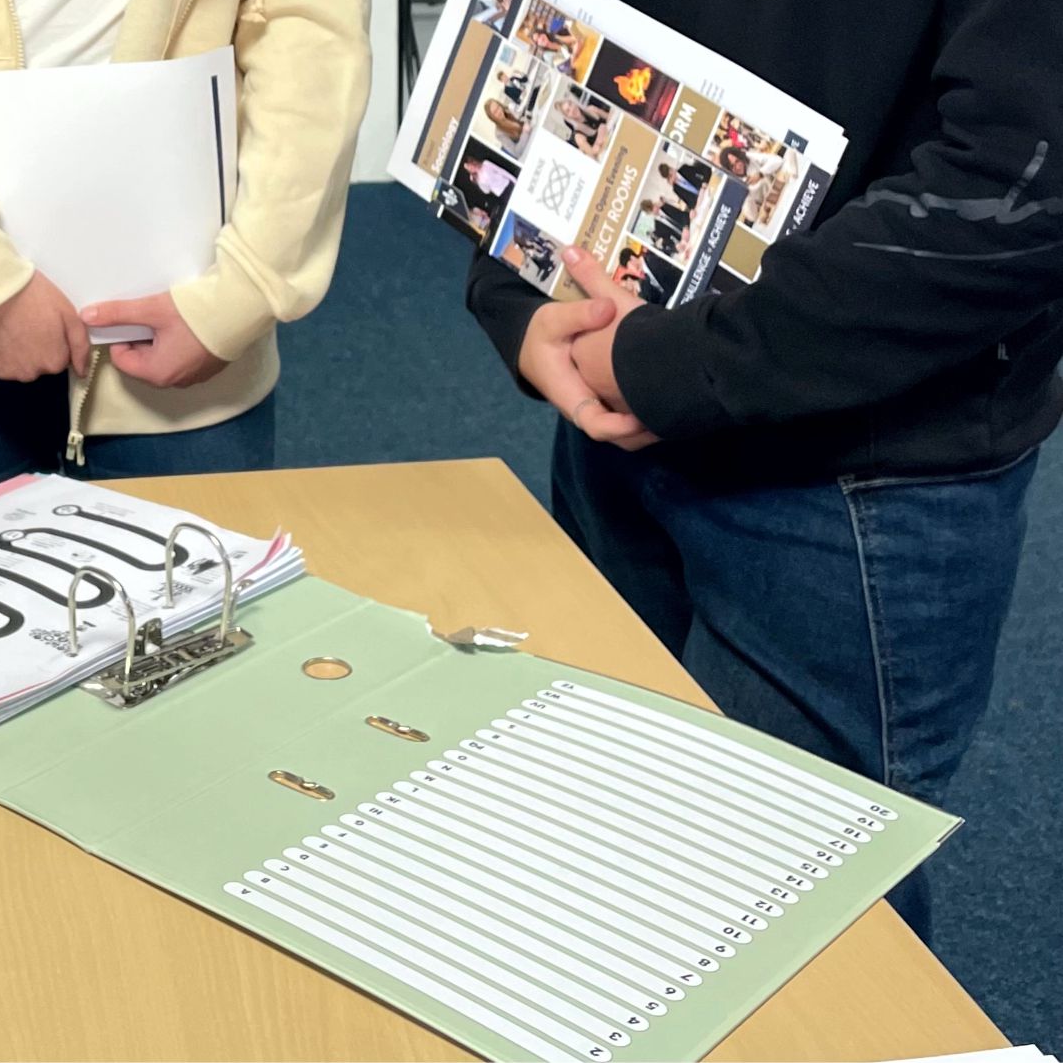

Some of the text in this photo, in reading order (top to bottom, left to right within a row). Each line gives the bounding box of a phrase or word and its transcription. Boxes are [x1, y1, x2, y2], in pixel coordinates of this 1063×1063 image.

[672, 102, 697, 145] ORM
[585, 145, 628, 238] Form Open Evening
[795, 179, 820, 227] ACHIEVE
[592, 165, 638, 261] JECT ROOMS
[707, 203, 732, 250] ACHIEVE
[870, 805, 891, 816] 20
[857, 817, 875, 827] 19
[843, 827, 861, 838] 18
[829, 840, 847, 850] 17
[817, 851, 833, 861] 16
[800, 863, 818, 874] 15
[785, 875, 804, 886] 14
[770, 887, 788, 899] 13
[755, 900, 773, 912] 12
[741, 914, 758, 925] 11
[723, 927, 741, 939] 10
[698, 958, 711, 967] 8
[665, 987, 676, 995] 6
[645, 1002, 659, 1010] 5
[609, 1032, 622, 1041] 3
[589, 1047, 604, 1056] 2
